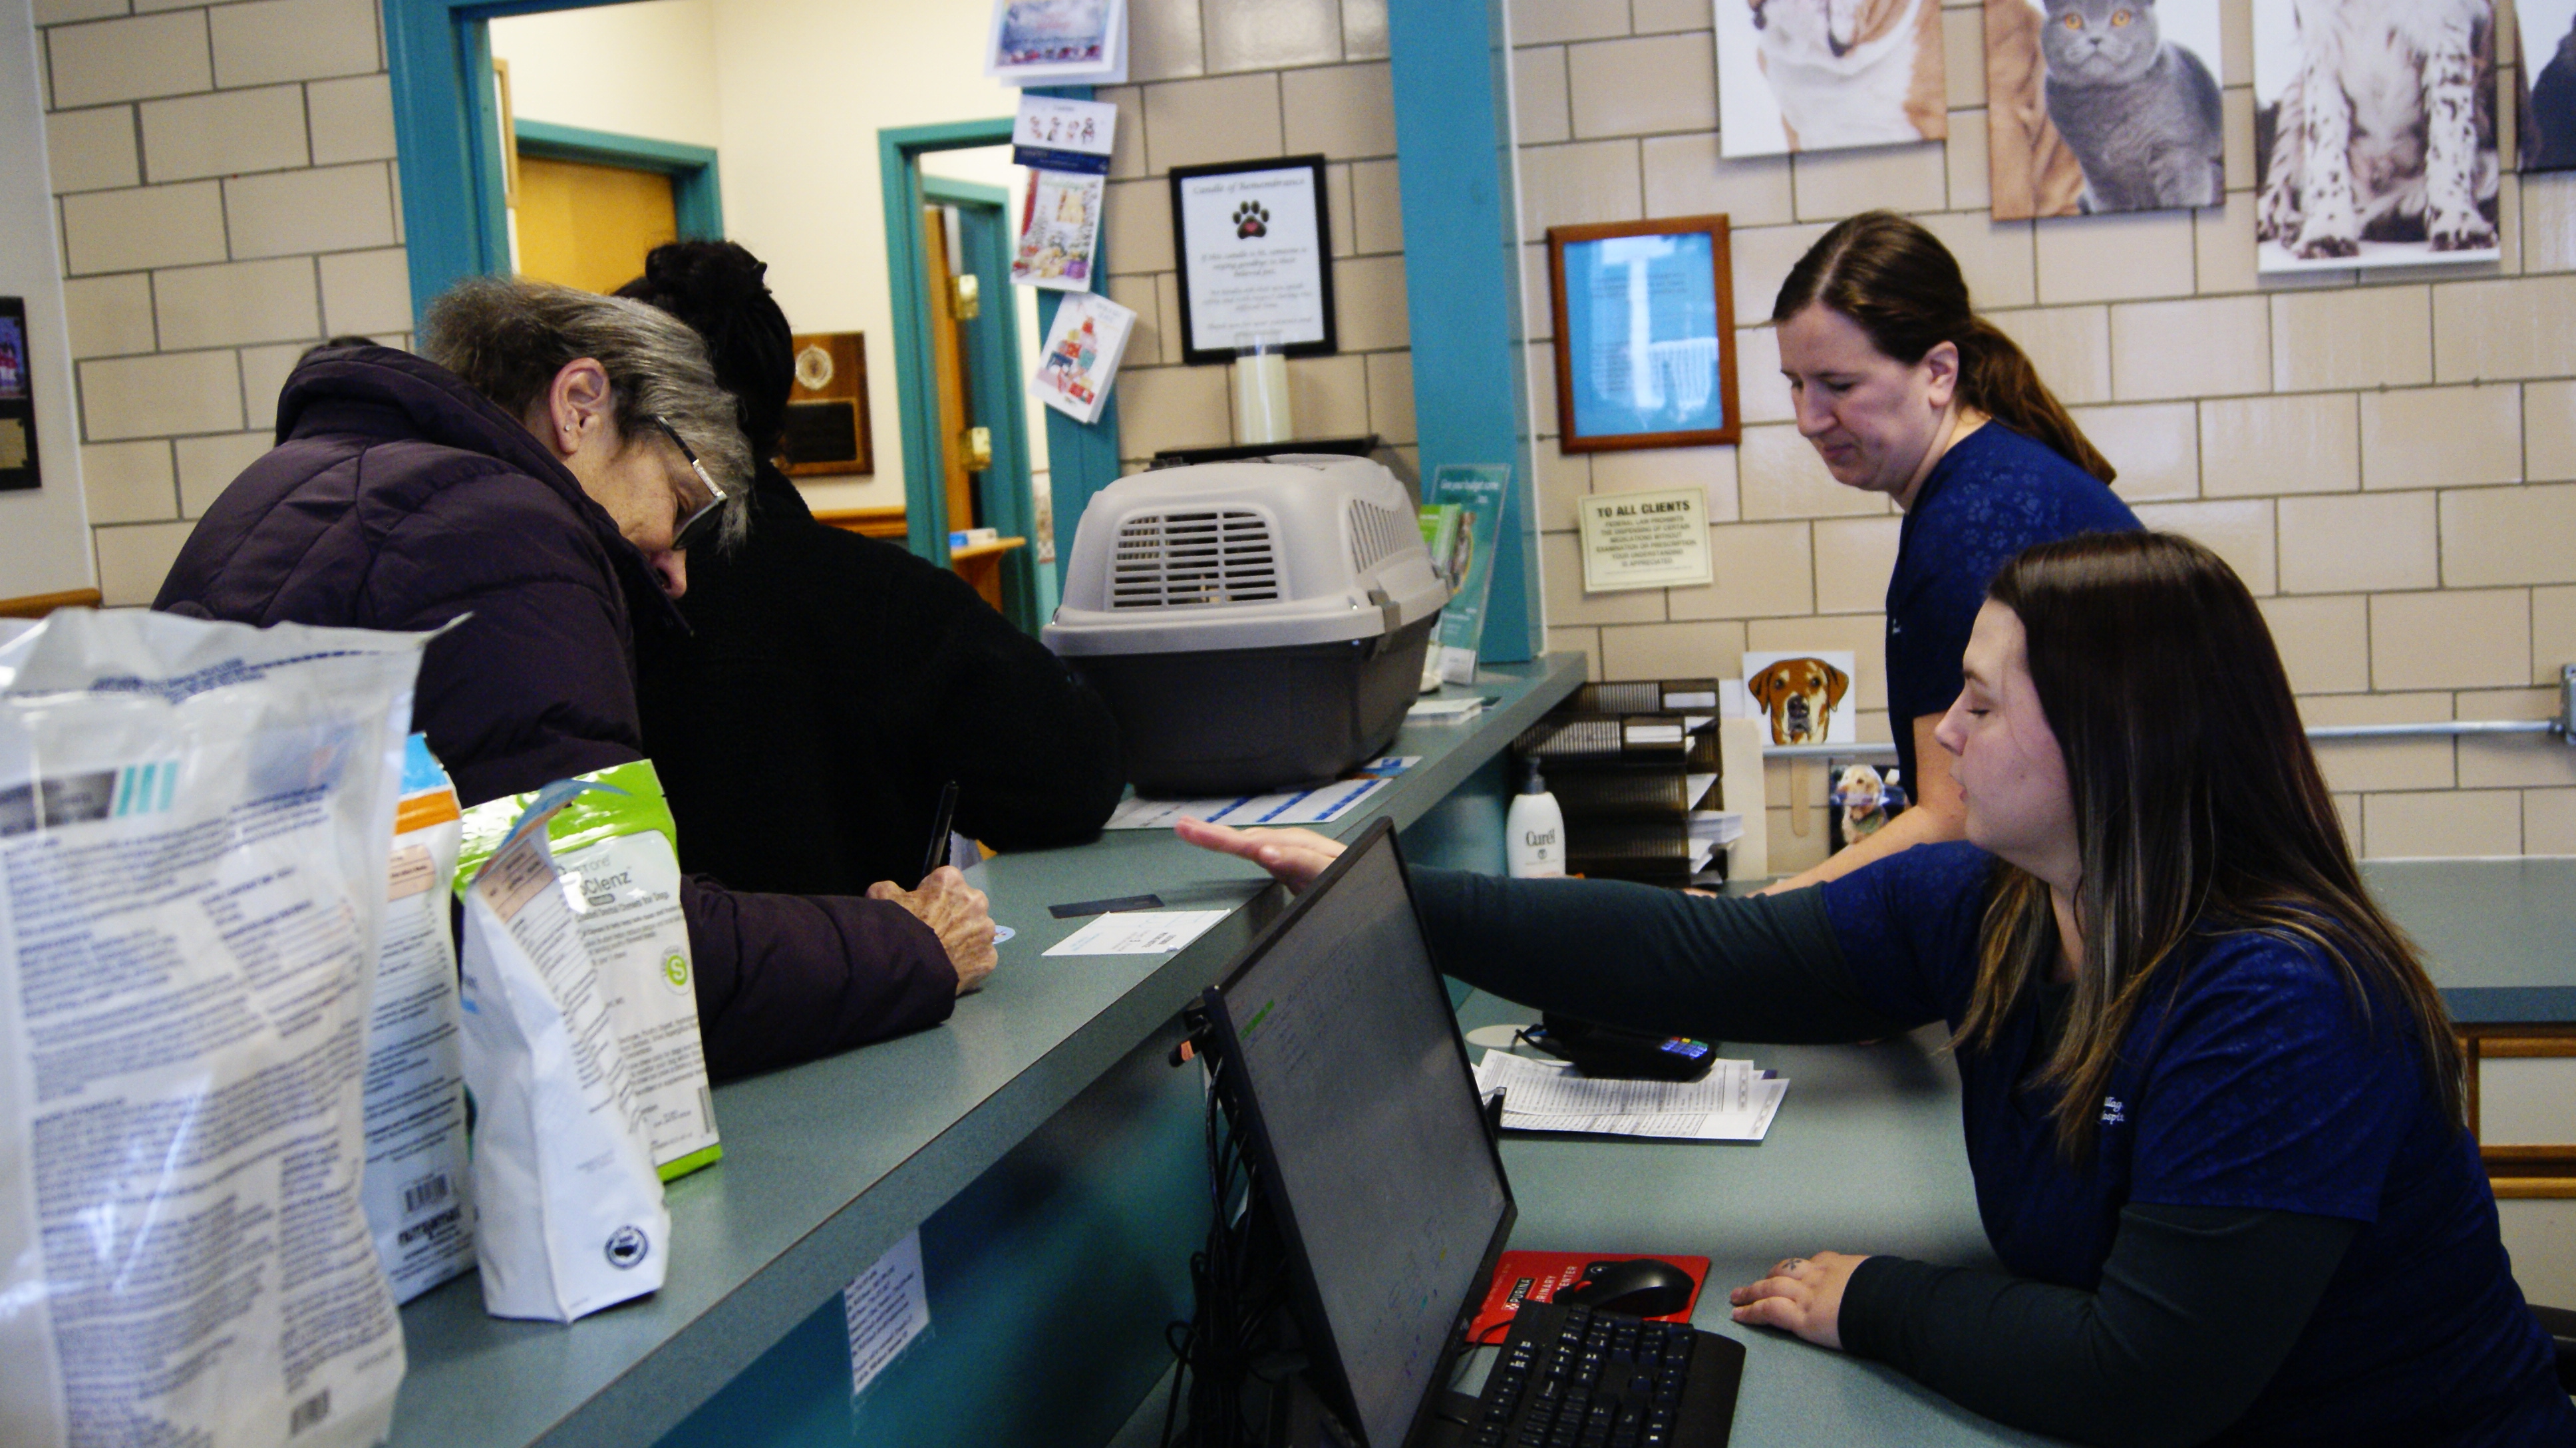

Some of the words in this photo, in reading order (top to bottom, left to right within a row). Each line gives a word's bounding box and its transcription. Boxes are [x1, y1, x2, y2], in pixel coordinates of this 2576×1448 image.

[1597, 507, 1613, 518] TO
[1617, 505, 1637, 516] ALL
[1641, 500, 1690, 514] CLIENTS
[670, 958, 685, 981] S
[1509, 1278, 1533, 1303] PURINA
[1534, 1275, 1557, 1303] RINARY
